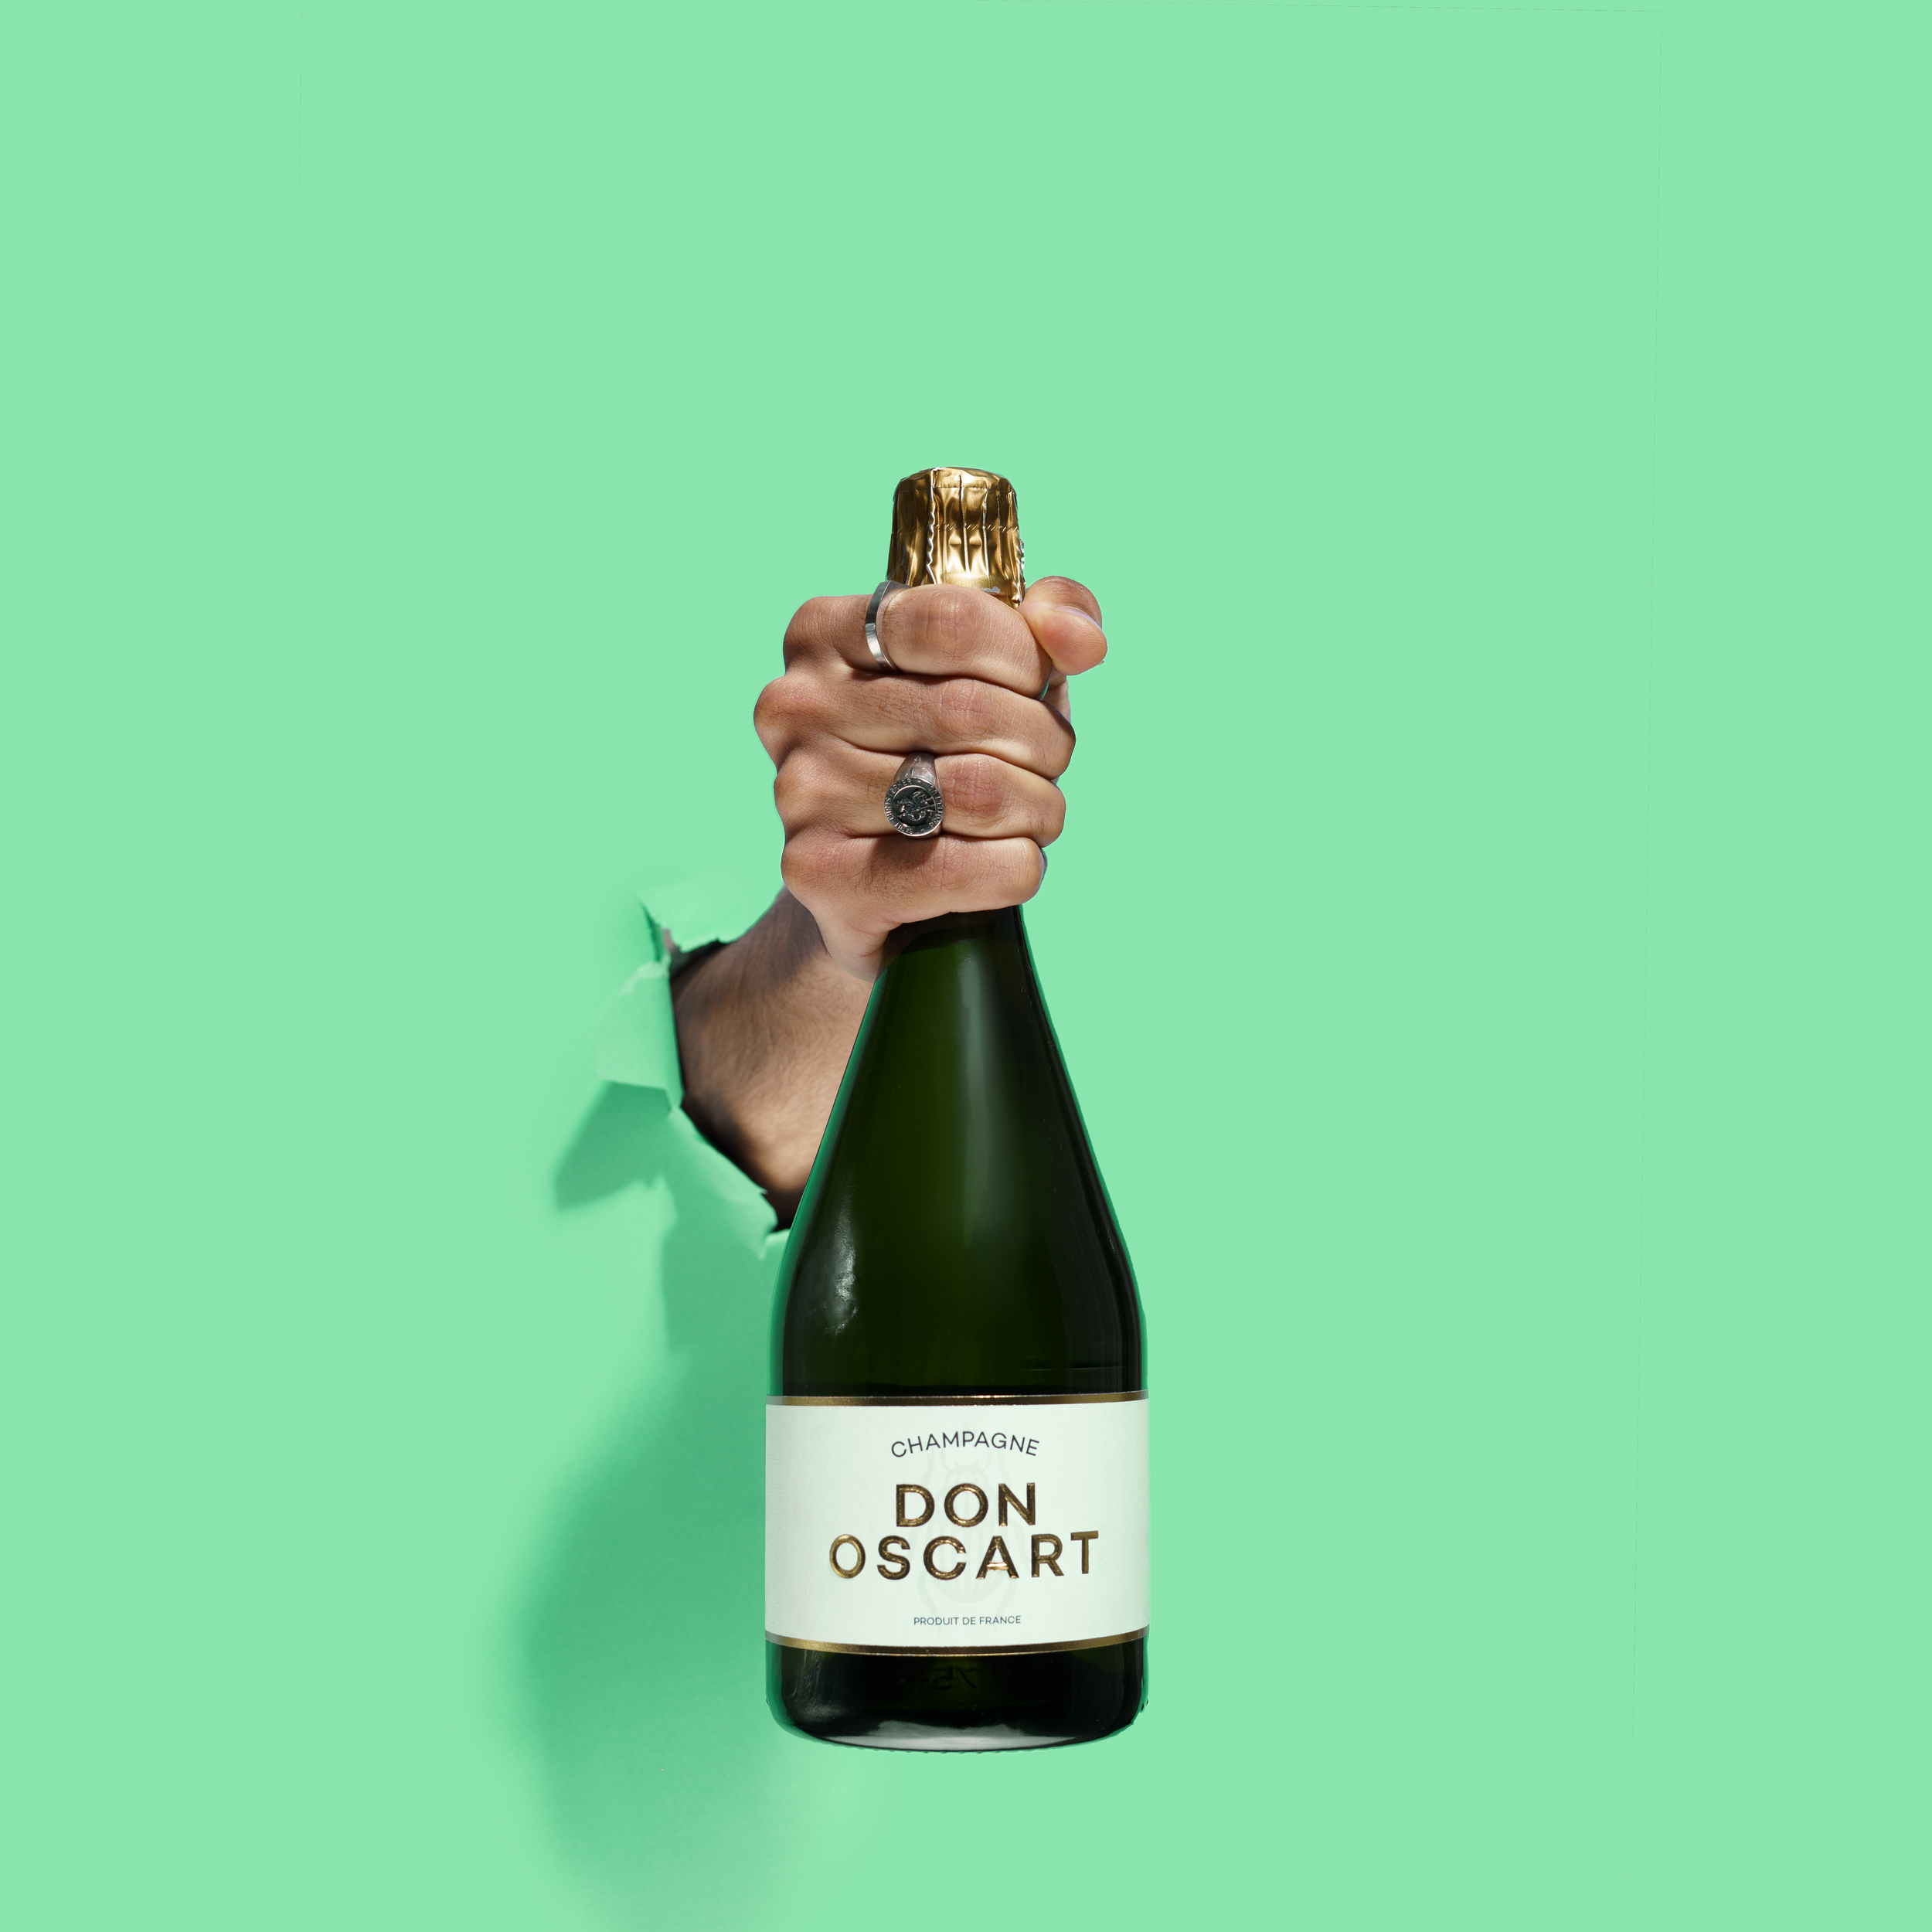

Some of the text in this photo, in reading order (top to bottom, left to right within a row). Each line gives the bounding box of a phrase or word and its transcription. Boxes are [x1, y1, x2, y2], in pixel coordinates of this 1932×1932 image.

[884, 778, 912, 820] CHRISTOPHER
[891, 1430, 1039, 1458] CHAMPAGNE
[896, 1482, 1036, 1527] DON
[829, 1530, 1099, 1581] OSCART
[913, 1615, 1022, 1626] PRODUIT DE FRANCE
